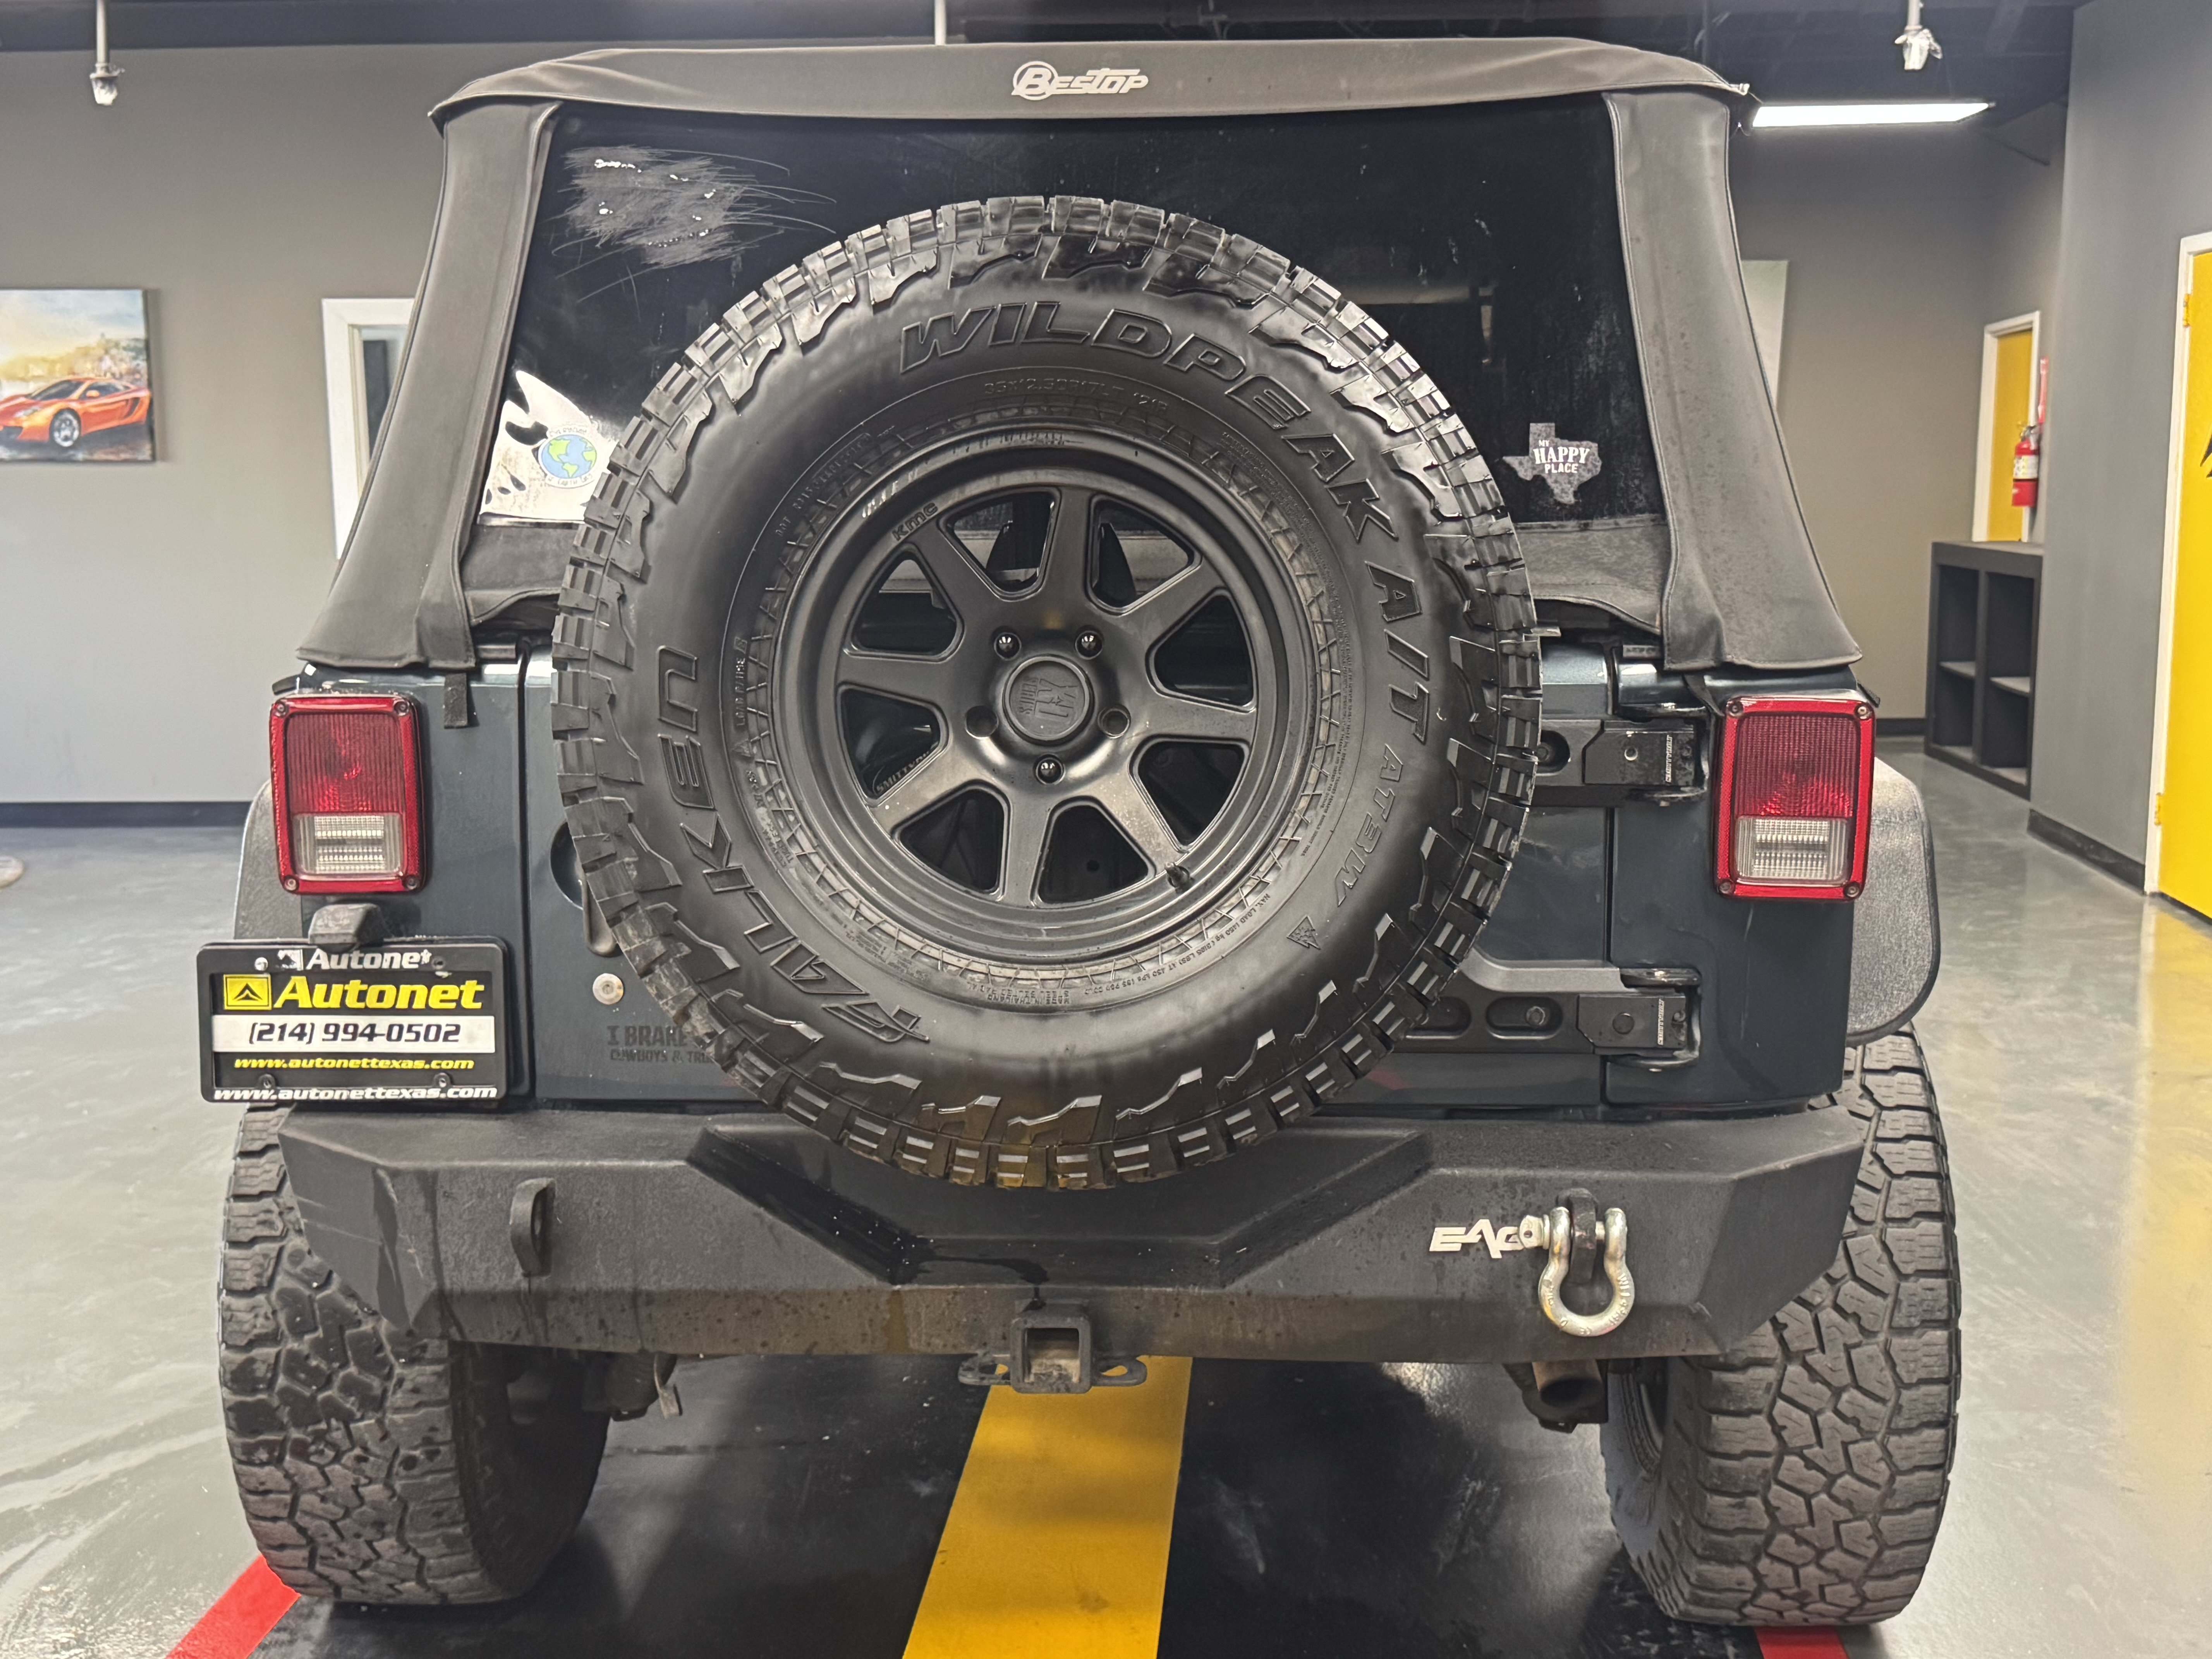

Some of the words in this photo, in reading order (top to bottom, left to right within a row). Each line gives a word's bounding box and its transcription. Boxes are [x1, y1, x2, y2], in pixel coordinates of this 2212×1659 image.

[900, 301, 1400, 542] WILDPEAK
[1533, 447, 1590, 464] HAPPY
[1545, 464, 1578, 473] PLACE
[657, 644, 929, 1043] FALKEN
[1239, 907, 1257, 925] LOAD
[273, 976, 485, 1009] Autonet
[249, 1022, 315, 1044] (214)
[322, 1023, 462, 1042] 994-0502
[607, 1025, 619, 1046] I
[234, 1058, 474, 1070] www.autonettexas.com
[214, 1086, 498, 1100] www.autonettexas.com
